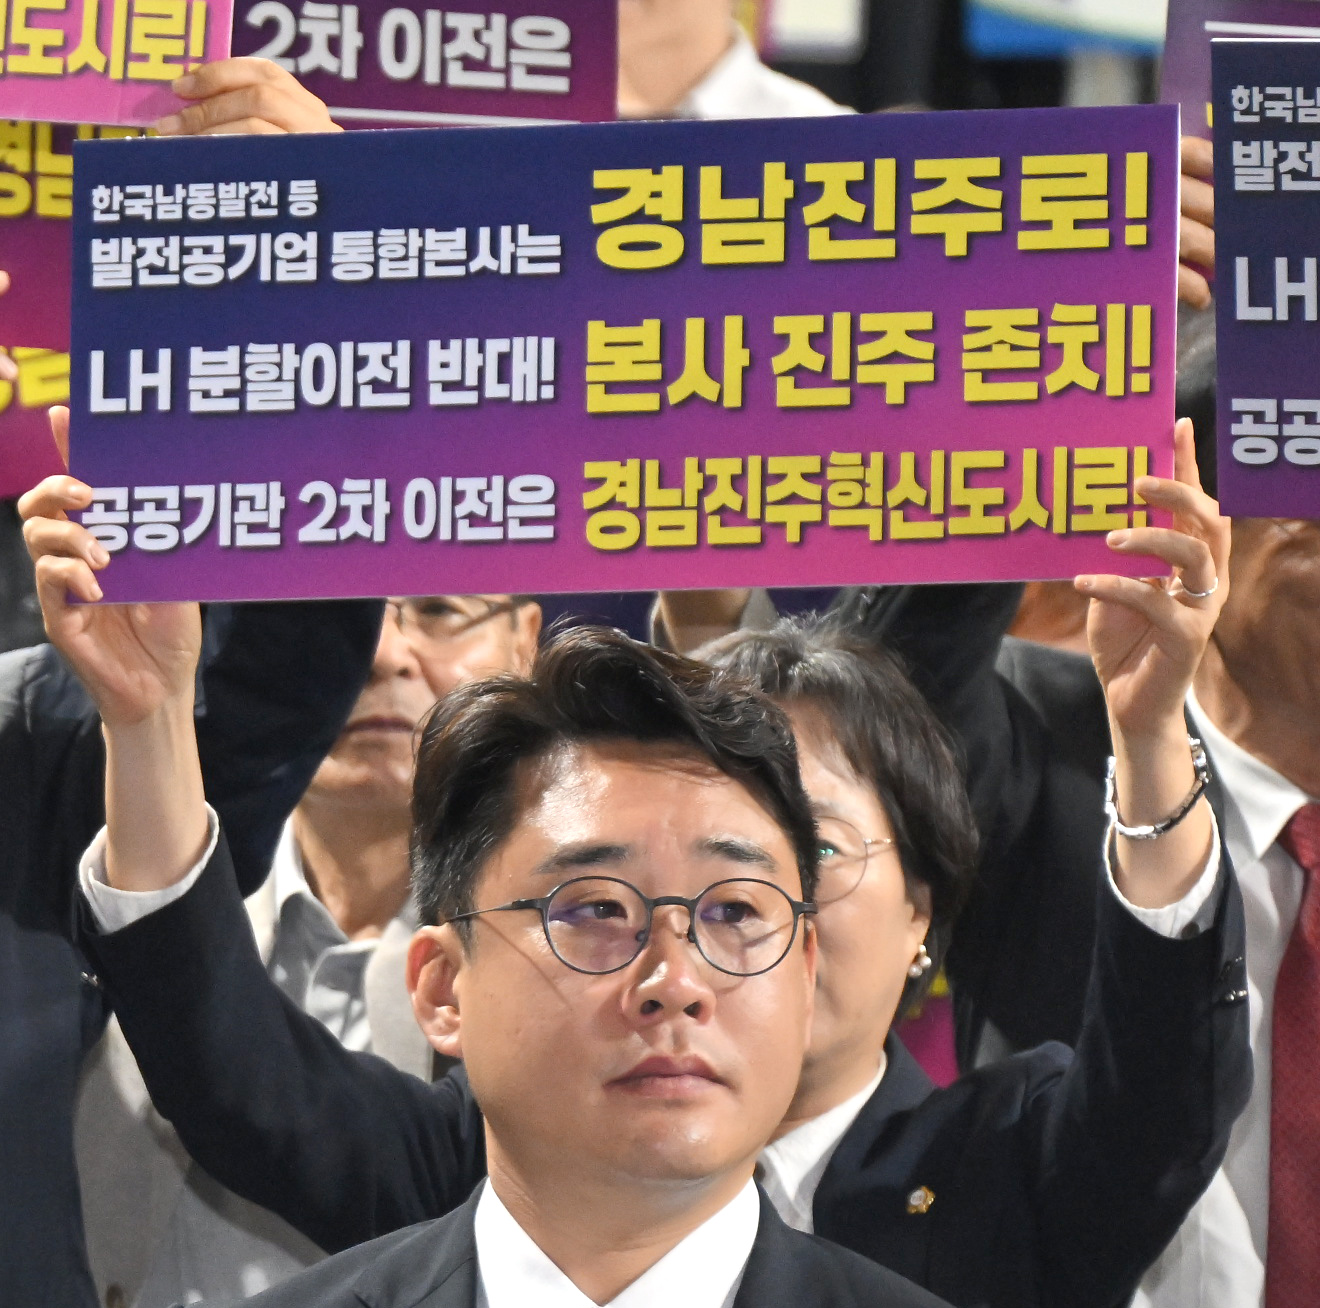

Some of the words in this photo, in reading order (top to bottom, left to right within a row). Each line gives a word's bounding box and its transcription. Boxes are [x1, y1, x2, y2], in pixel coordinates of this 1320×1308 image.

[245, 1, 363, 80] 2차
[379, 8, 571, 92] 이전은
[1232, 85, 1320, 122] 한국남
[1233, 141, 1320, 190] 발전
[92, 181, 278, 221] 한국남동발전
[288, 180, 318, 216] 등
[92, 232, 317, 287] 발전공기업
[331, 224, 561, 280] 통합본사는
[591, 152, 1147, 269] 경남진주로!
[1236, 257, 1317, 320] LH
[90, 349, 171, 412] LH
[189, 340, 410, 412] 분할이전
[428, 336, 554, 405] 반대!
[586, 315, 749, 412] 본사
[772, 312, 934, 406] 진주
[962, 303, 1151, 401] 존치!
[1231, 398, 1320, 465] 공공
[82, 481, 286, 553] 공공기관
[298, 478, 390, 542] 2차
[403, 475, 555, 540] 이전은
[583, 446, 1148, 549] 경남진주혁신도시로!
